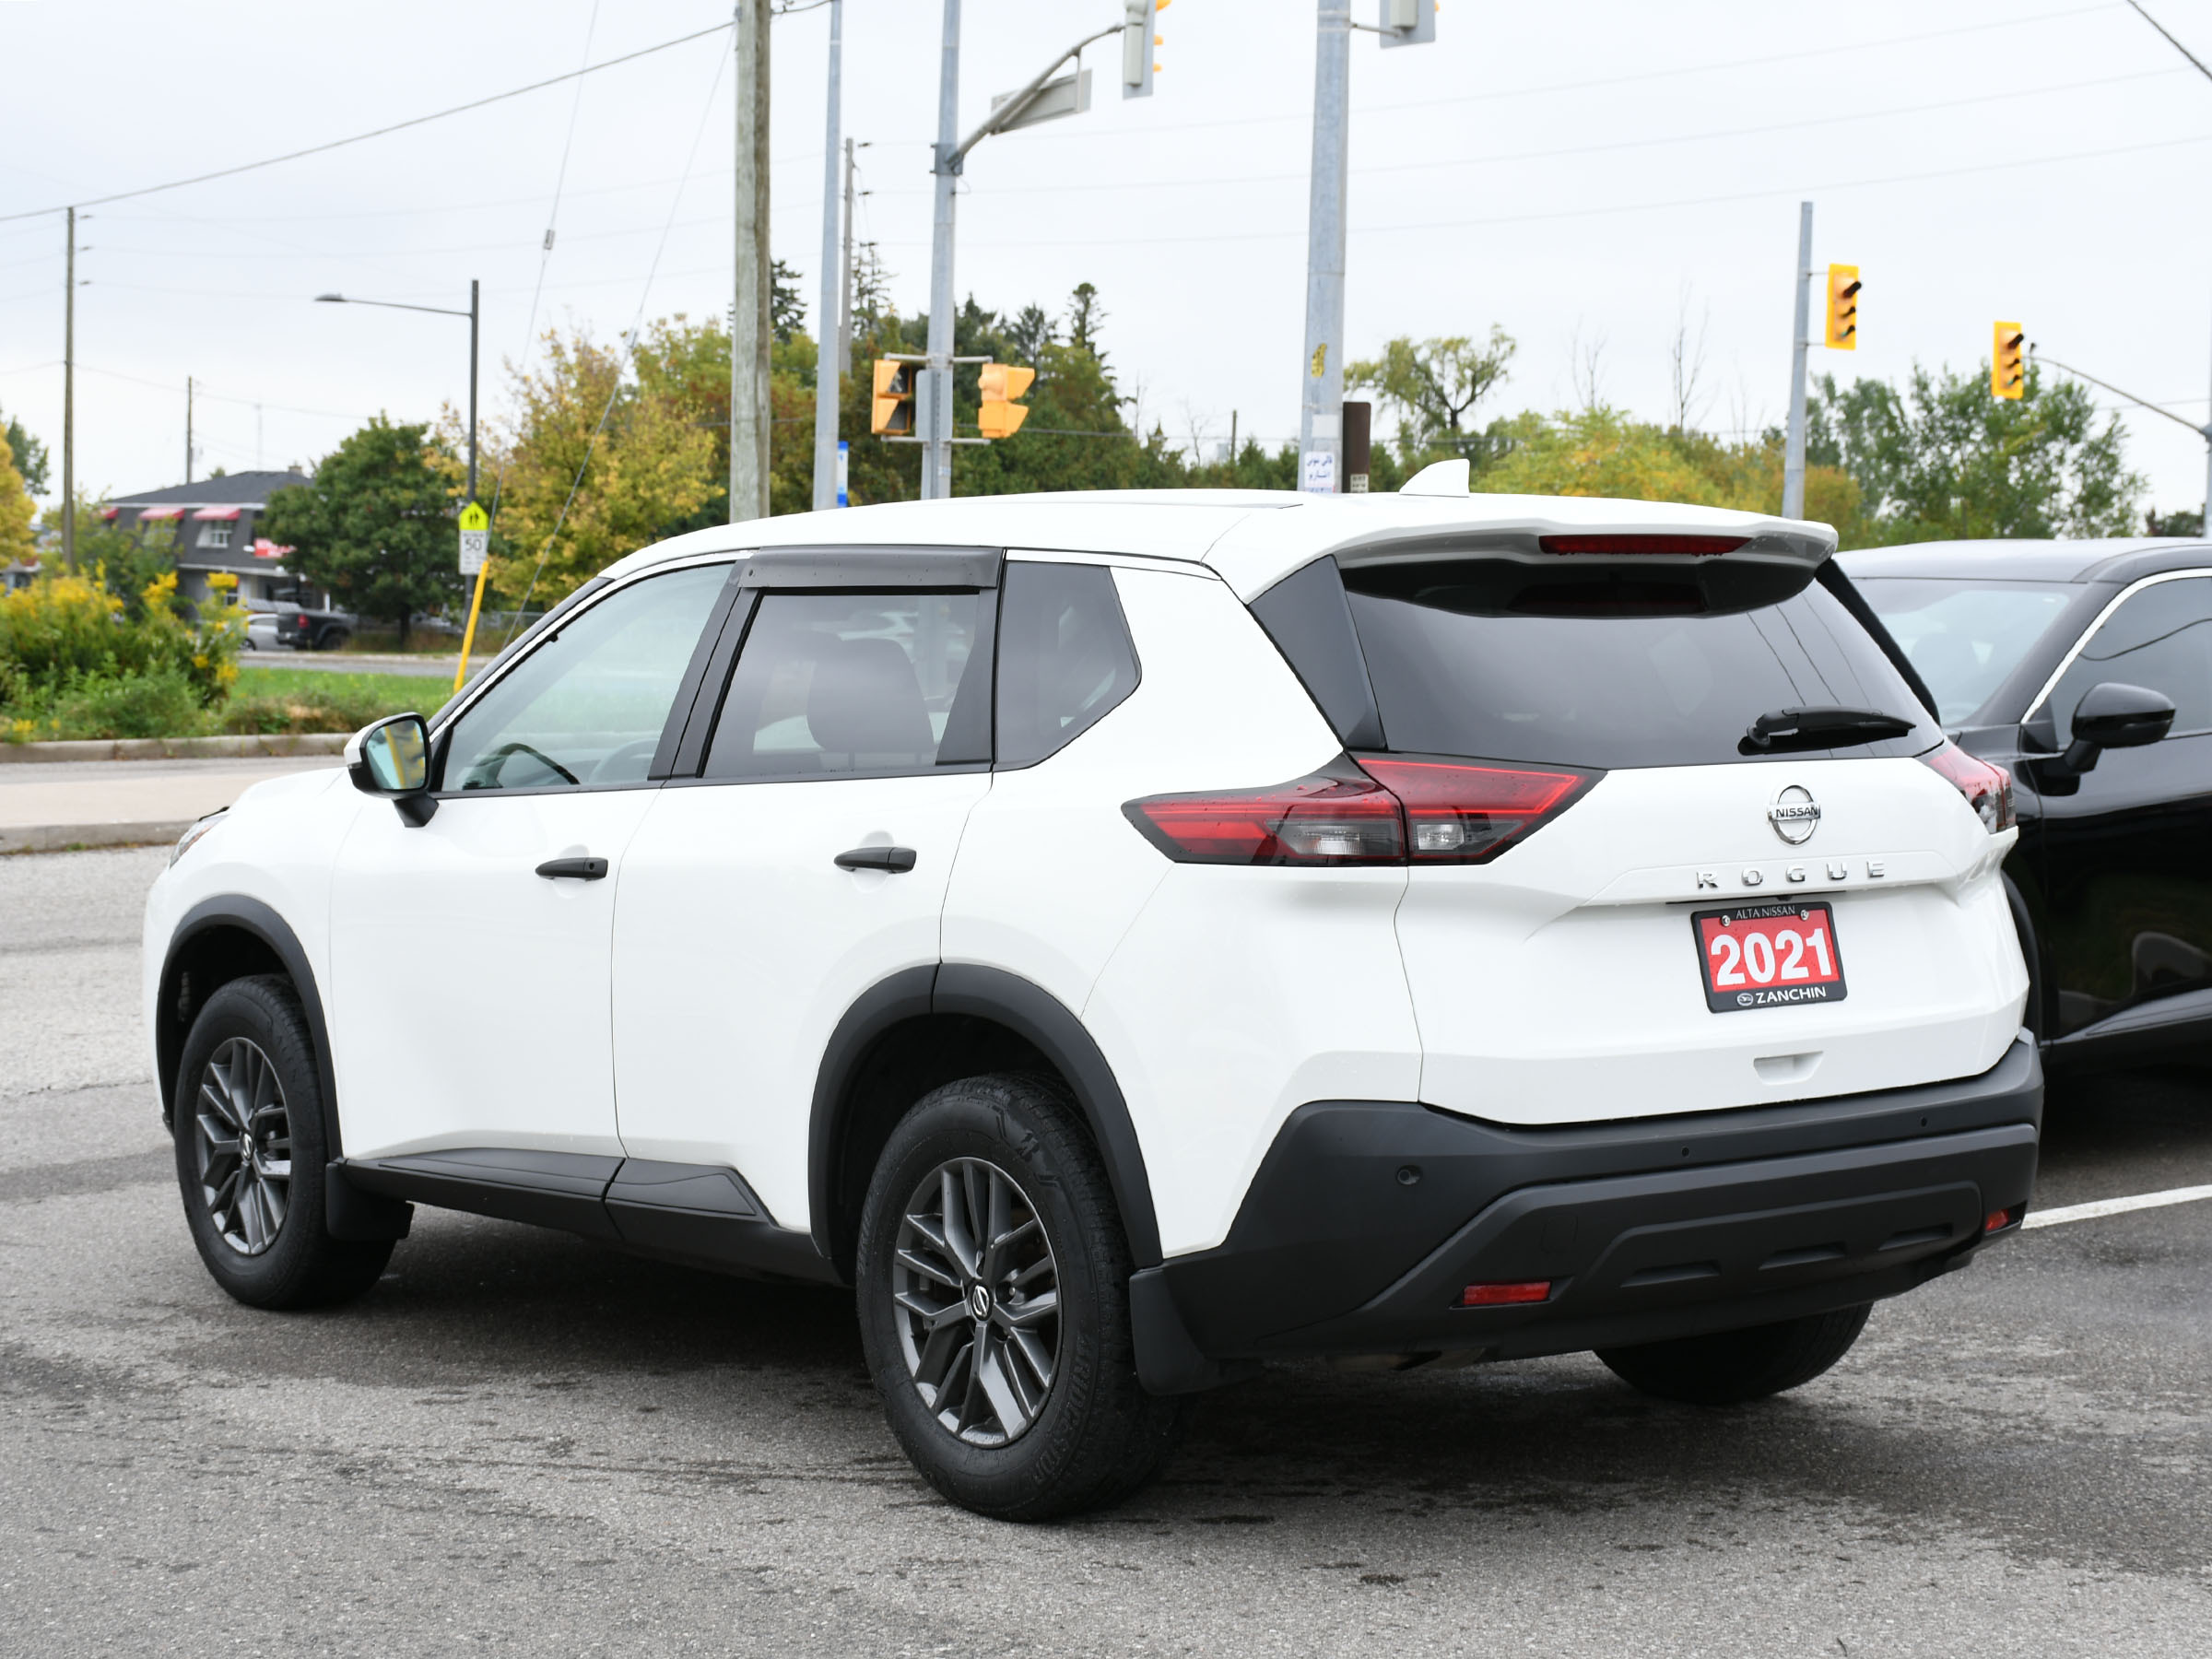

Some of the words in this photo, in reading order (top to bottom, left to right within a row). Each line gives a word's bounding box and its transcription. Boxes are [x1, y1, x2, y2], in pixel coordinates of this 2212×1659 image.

[465, 538, 482, 551] 50
[1776, 806, 1818, 818] NISSAN
[1696, 861, 1886, 889] ROGUE
[1735, 908, 1760, 920] ALTA
[1761, 905, 1796, 917] NISSAN
[1711, 927, 1832, 986] 2021
[1755, 985, 1827, 1004] ZANCHIN
